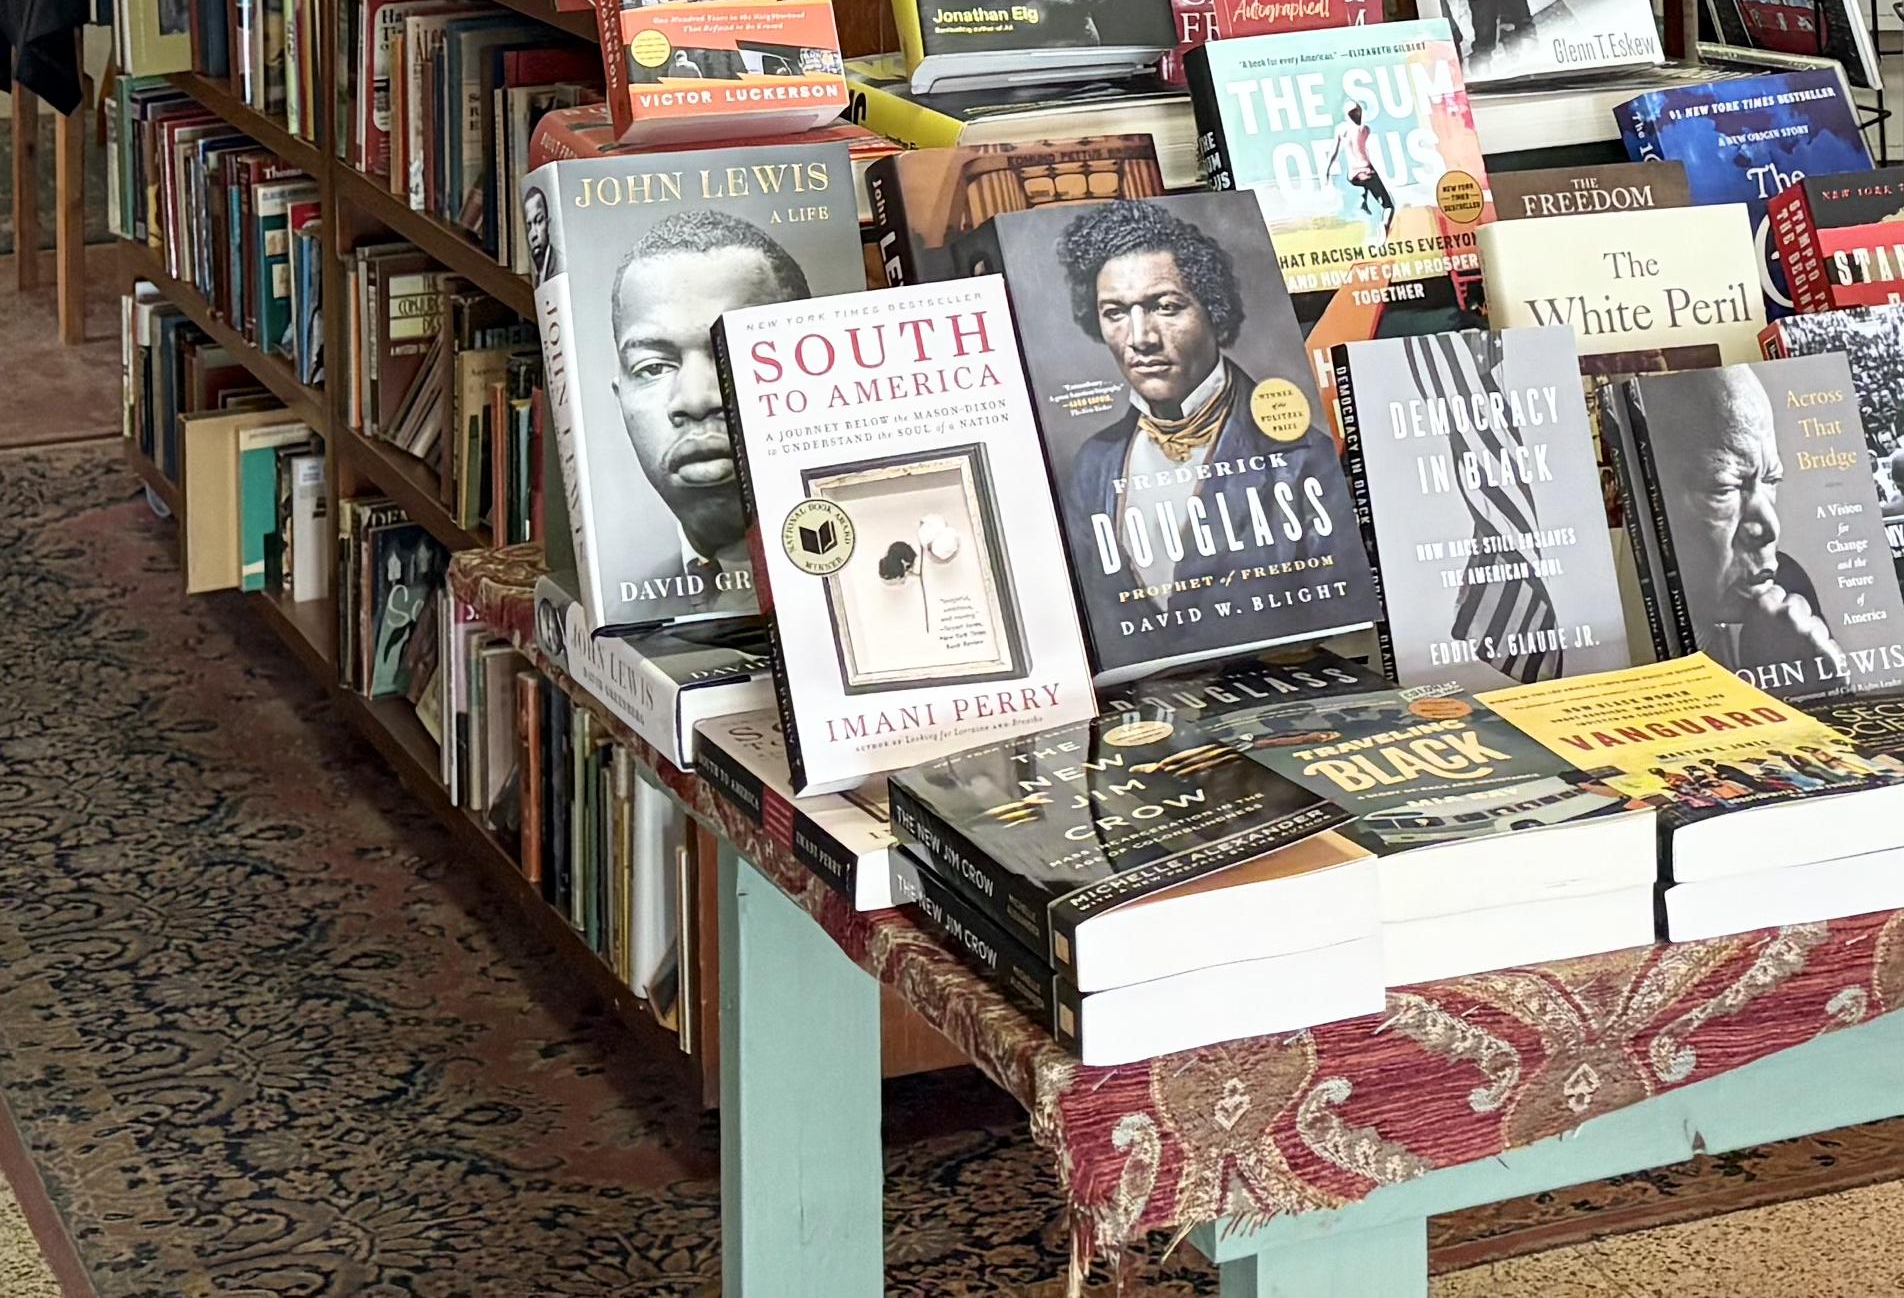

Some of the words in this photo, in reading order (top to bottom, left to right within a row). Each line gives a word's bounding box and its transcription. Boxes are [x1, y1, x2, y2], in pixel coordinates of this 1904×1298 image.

[932, 6, 1009, 24] Jonathan
[1552, 36, 1594, 64] Glenn
[1595, 35, 1609, 60] T.
[1610, 31, 1655, 59] Eskew
[639, 91, 713, 108] VICTOR
[725, 84, 839, 102] LUCKERSON
[573, 169, 685, 209] JOHN
[698, 161, 831, 200] LEWIS
[1523, 185, 1655, 219] FREEDOM
[749, 308, 999, 385] SOUTH
[758, 390, 809, 418] TO
[826, 363, 1004, 411] AMERICA
[1090, 476, 1335, 576] DOUGLASS
[826, 704, 938, 743] IMANI
[952, 682, 1064, 723] PERRY
[1560, 701, 1788, 754] VANGUARD
